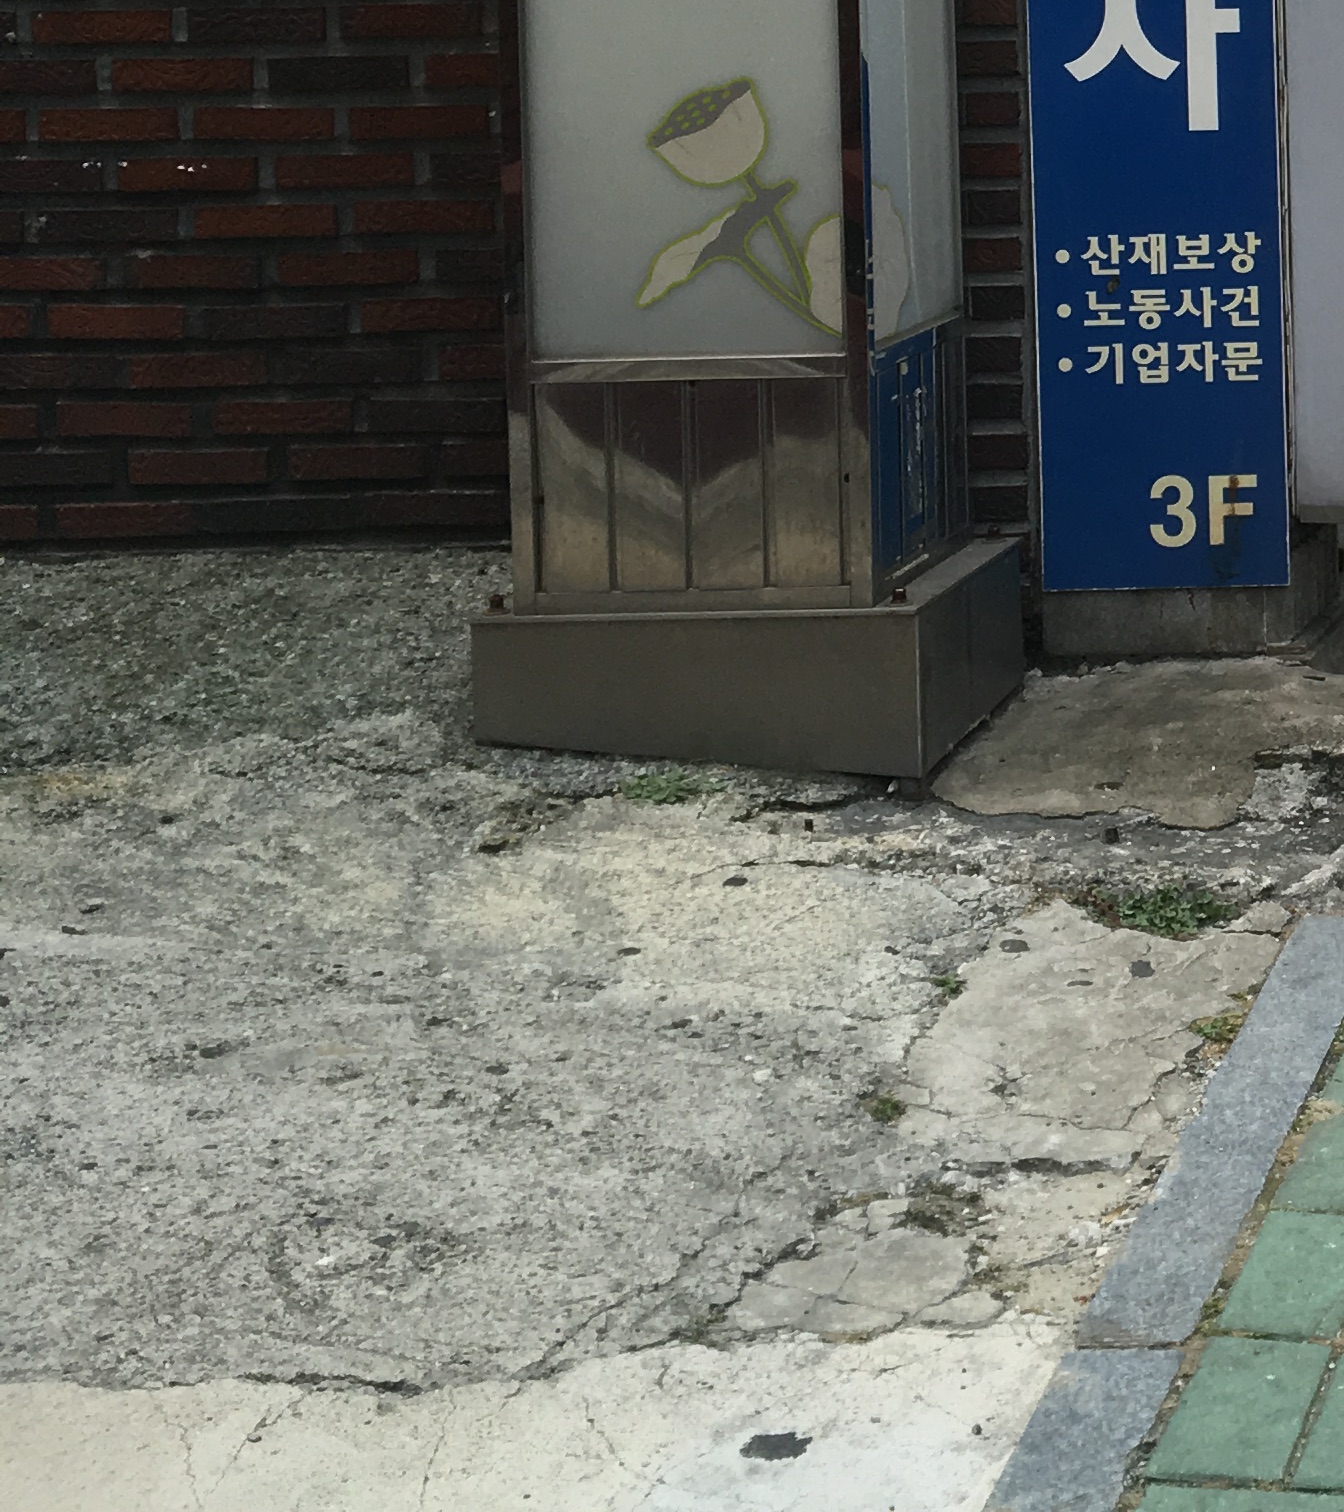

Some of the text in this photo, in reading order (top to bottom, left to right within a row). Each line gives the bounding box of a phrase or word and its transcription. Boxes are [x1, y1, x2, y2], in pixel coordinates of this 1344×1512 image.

[1081, 231, 1262, 276] 산재보상
[1083, 285, 1261, 330] 노동사건
[1085, 341, 1263, 385] 기업자문
[1149, 473, 1259, 548] 3F
